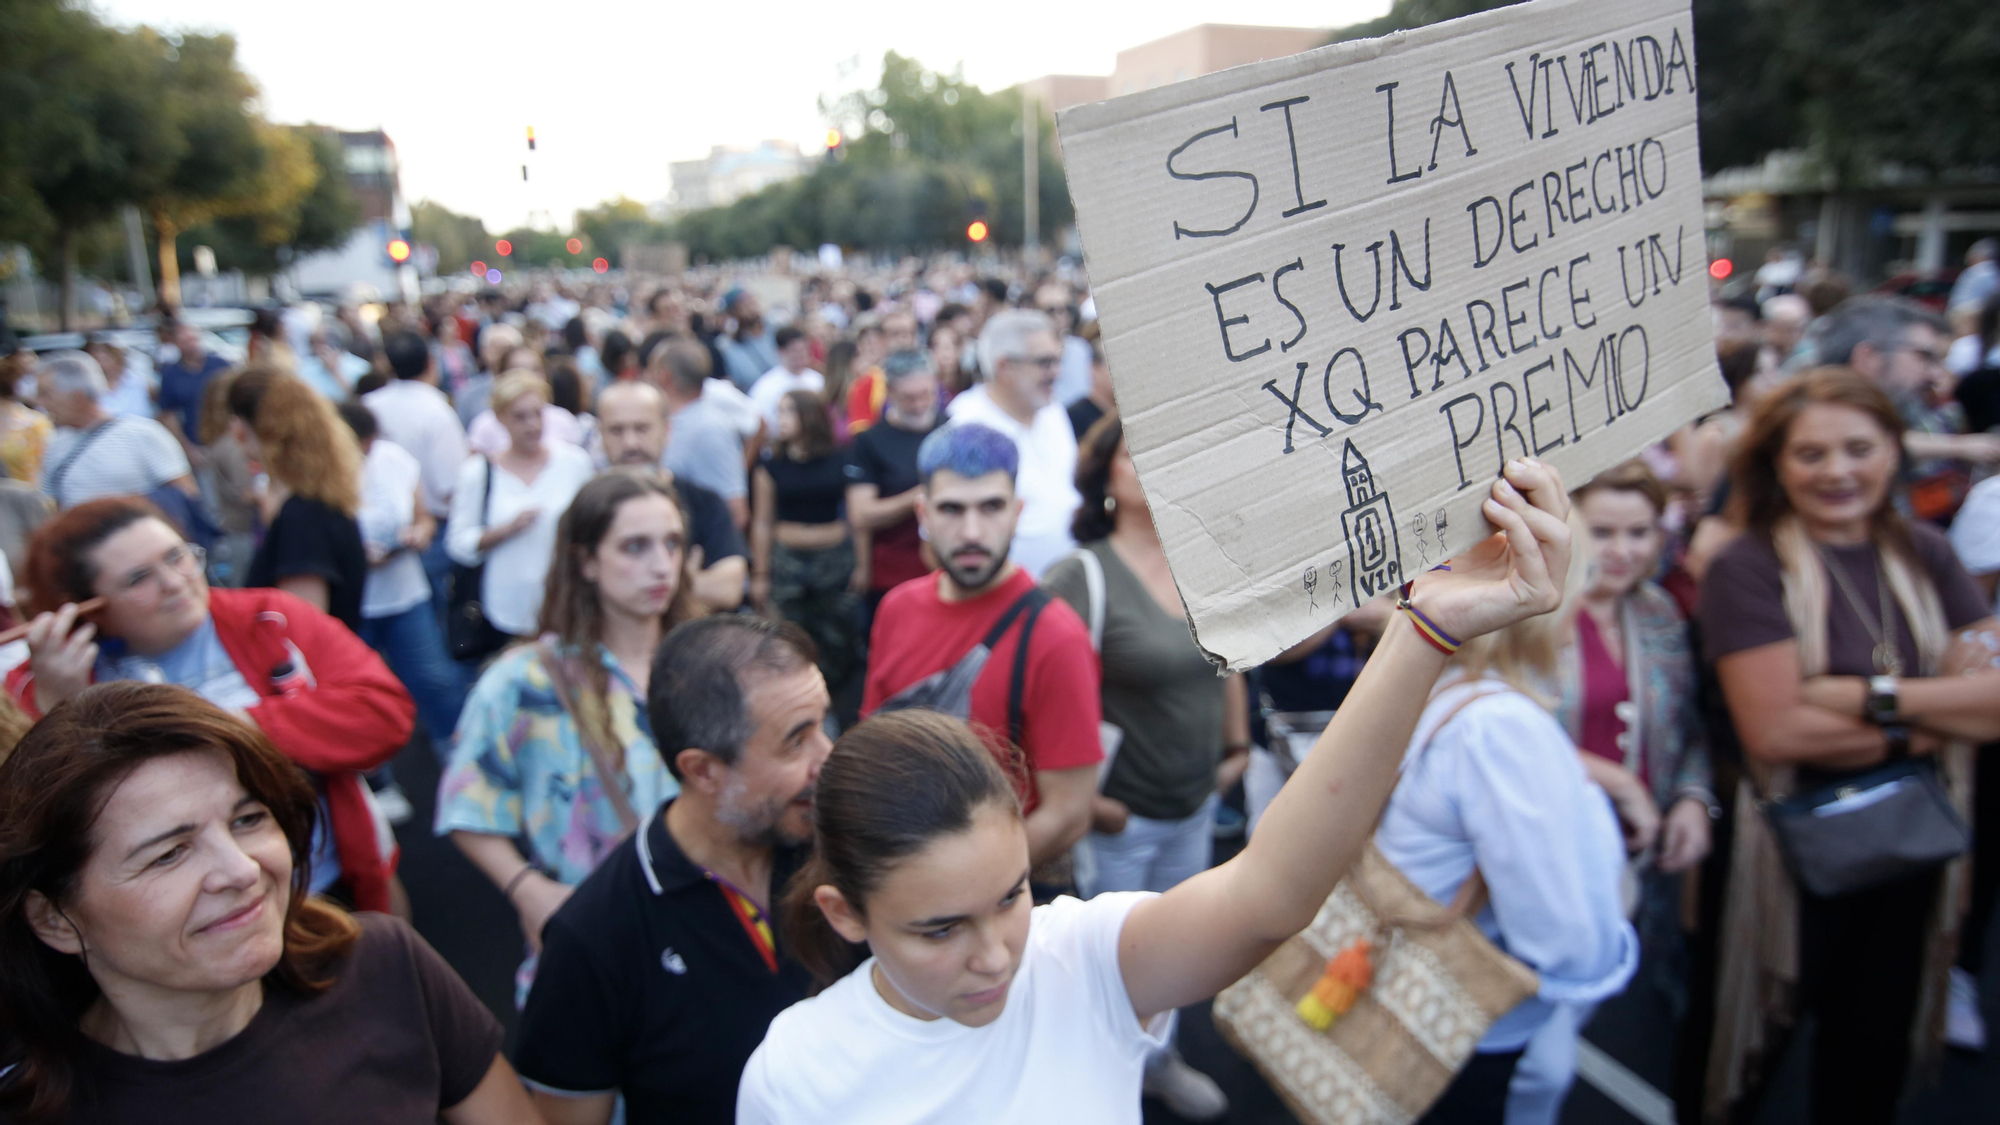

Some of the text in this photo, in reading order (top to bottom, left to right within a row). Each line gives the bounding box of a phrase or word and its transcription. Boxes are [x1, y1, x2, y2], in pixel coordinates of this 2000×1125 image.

[1166, 27, 1695, 240] SI LA VIVIENDA
[1204, 137, 1667, 362] ES UN DERECHO
[1261, 224, 1684, 454] XQ PARECE UN
[1439, 324, 1650, 491] PREMIO
[1360, 560, 1398, 597] VIP
